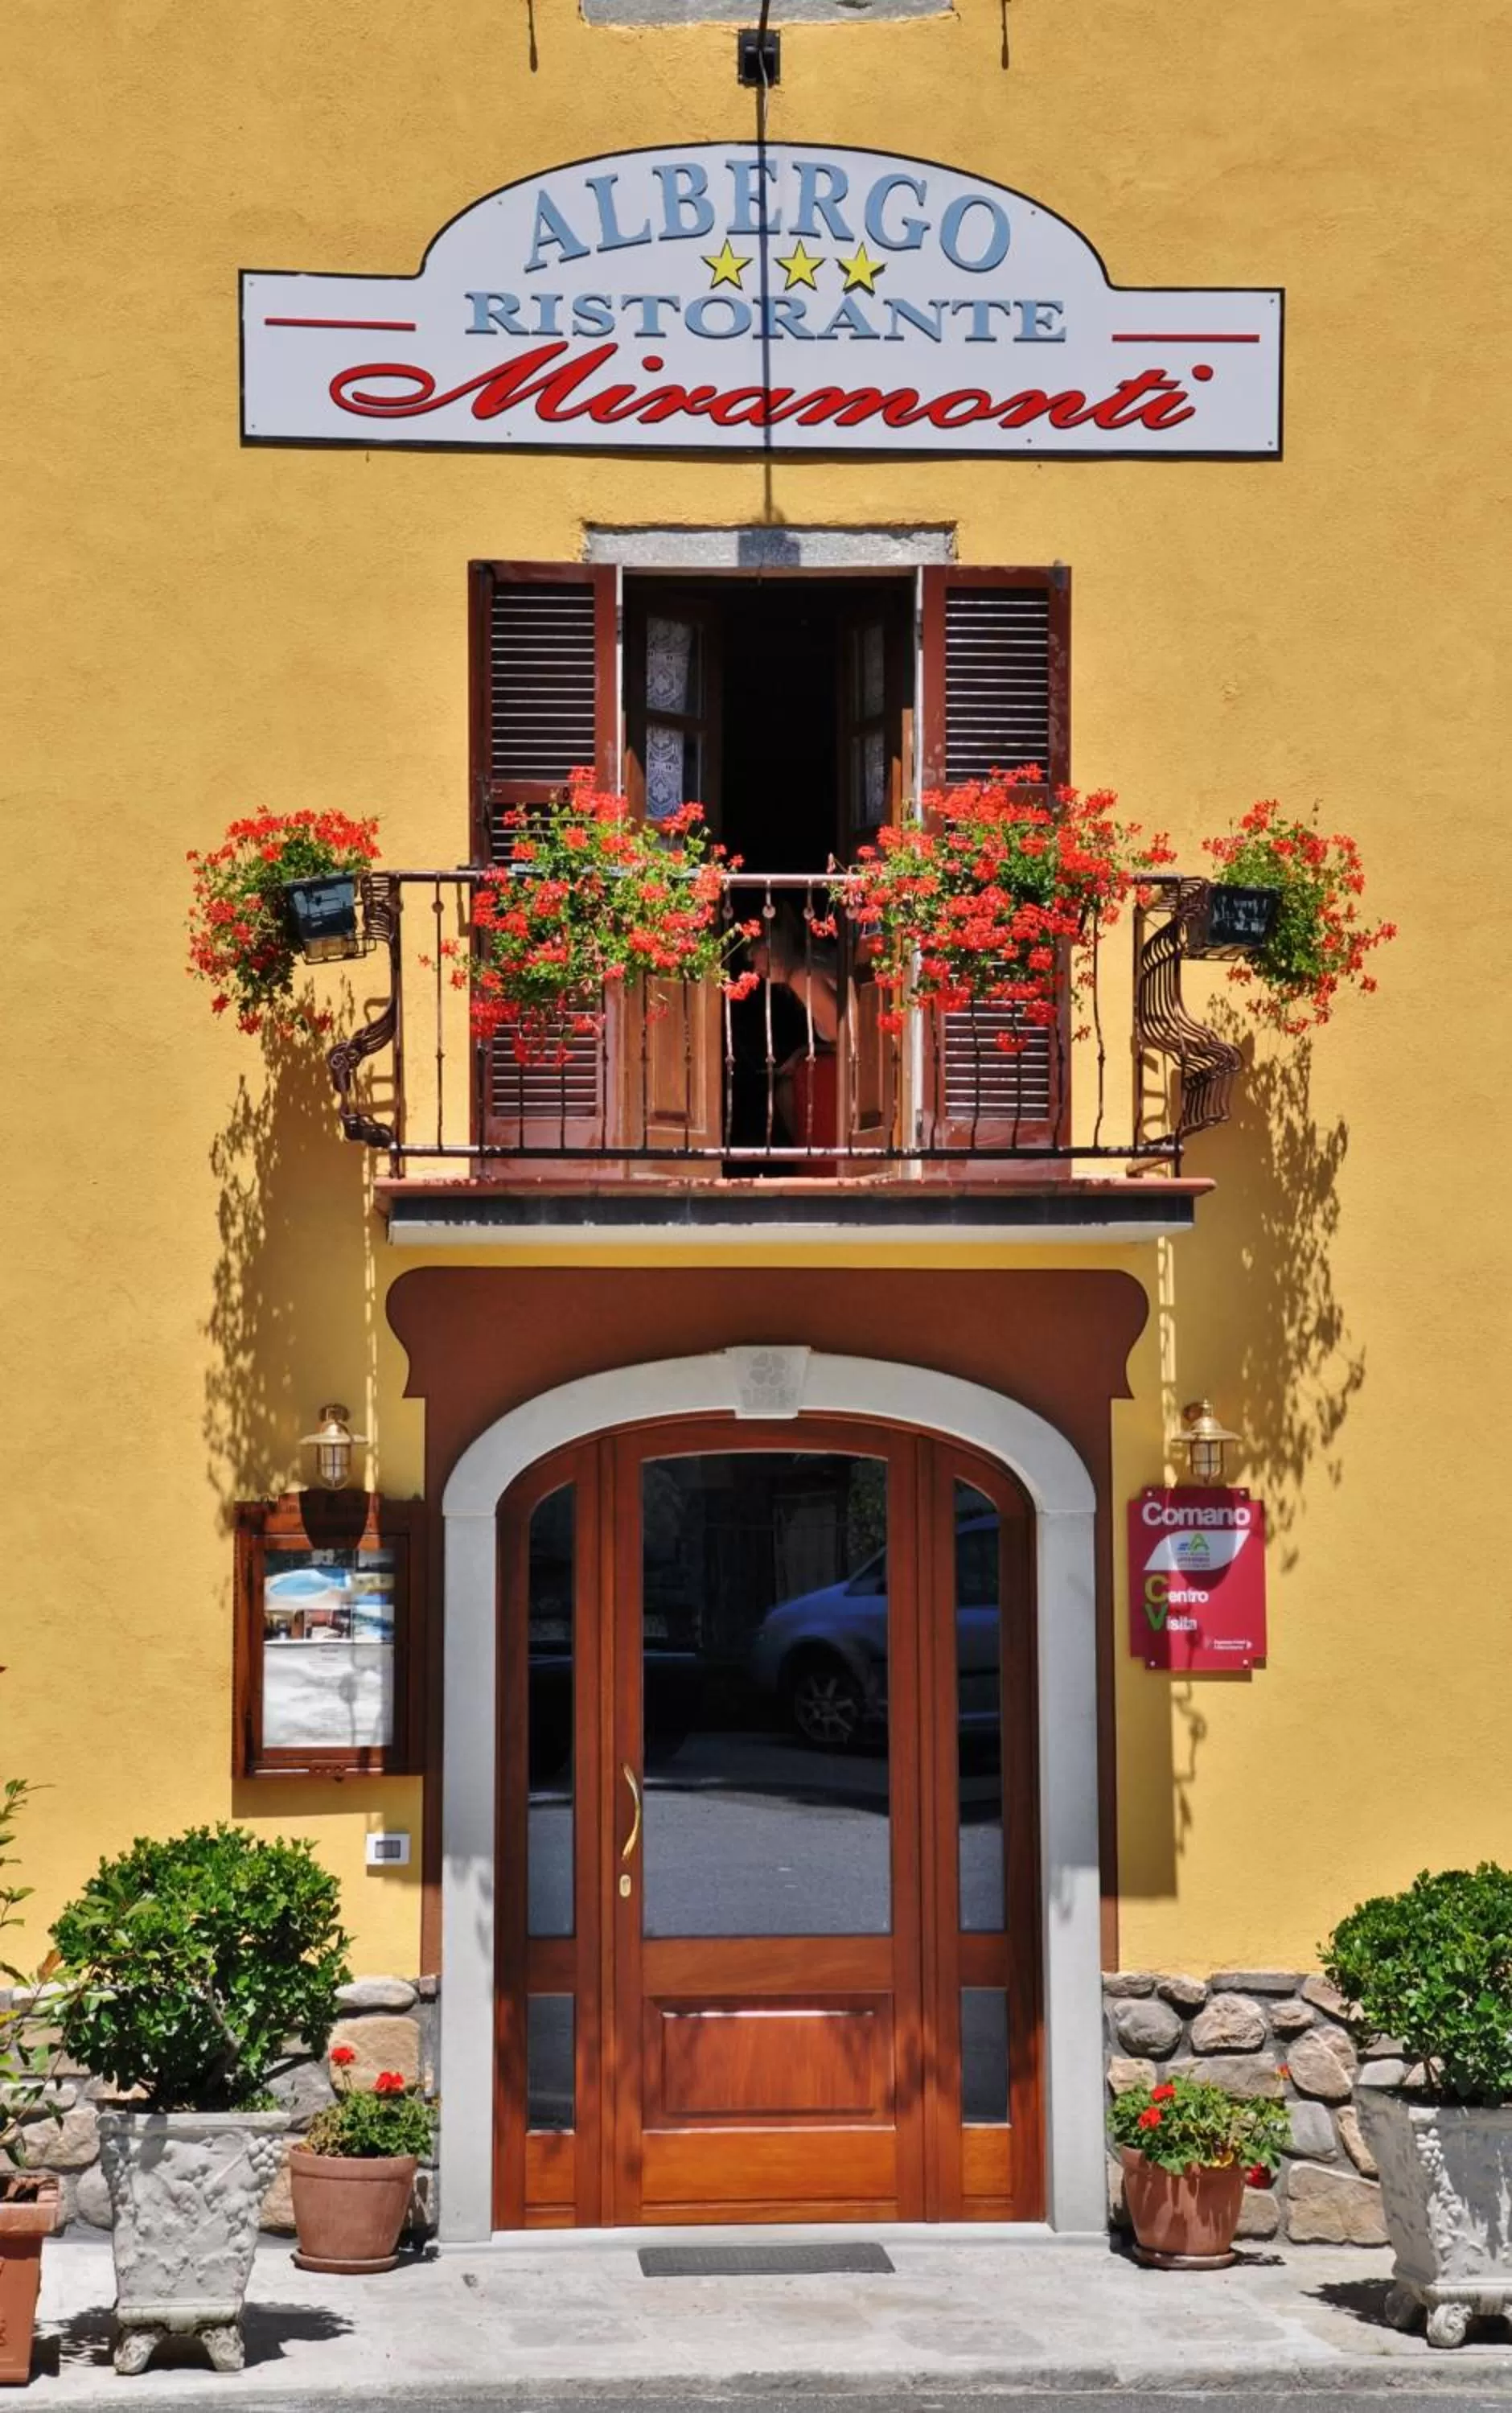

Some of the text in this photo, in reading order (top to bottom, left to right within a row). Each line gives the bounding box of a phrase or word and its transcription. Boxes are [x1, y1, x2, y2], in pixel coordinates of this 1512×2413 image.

[524, 158, 1011, 273] ALBERGO
[464, 291, 1067, 343] RISTORANTE
[328, 340, 1214, 431] Miramonti
[1142, 1502, 1251, 1526] Comano
[1145, 1575, 1210, 1603] Centro
[1144, 1603, 1198, 1631] Visita
